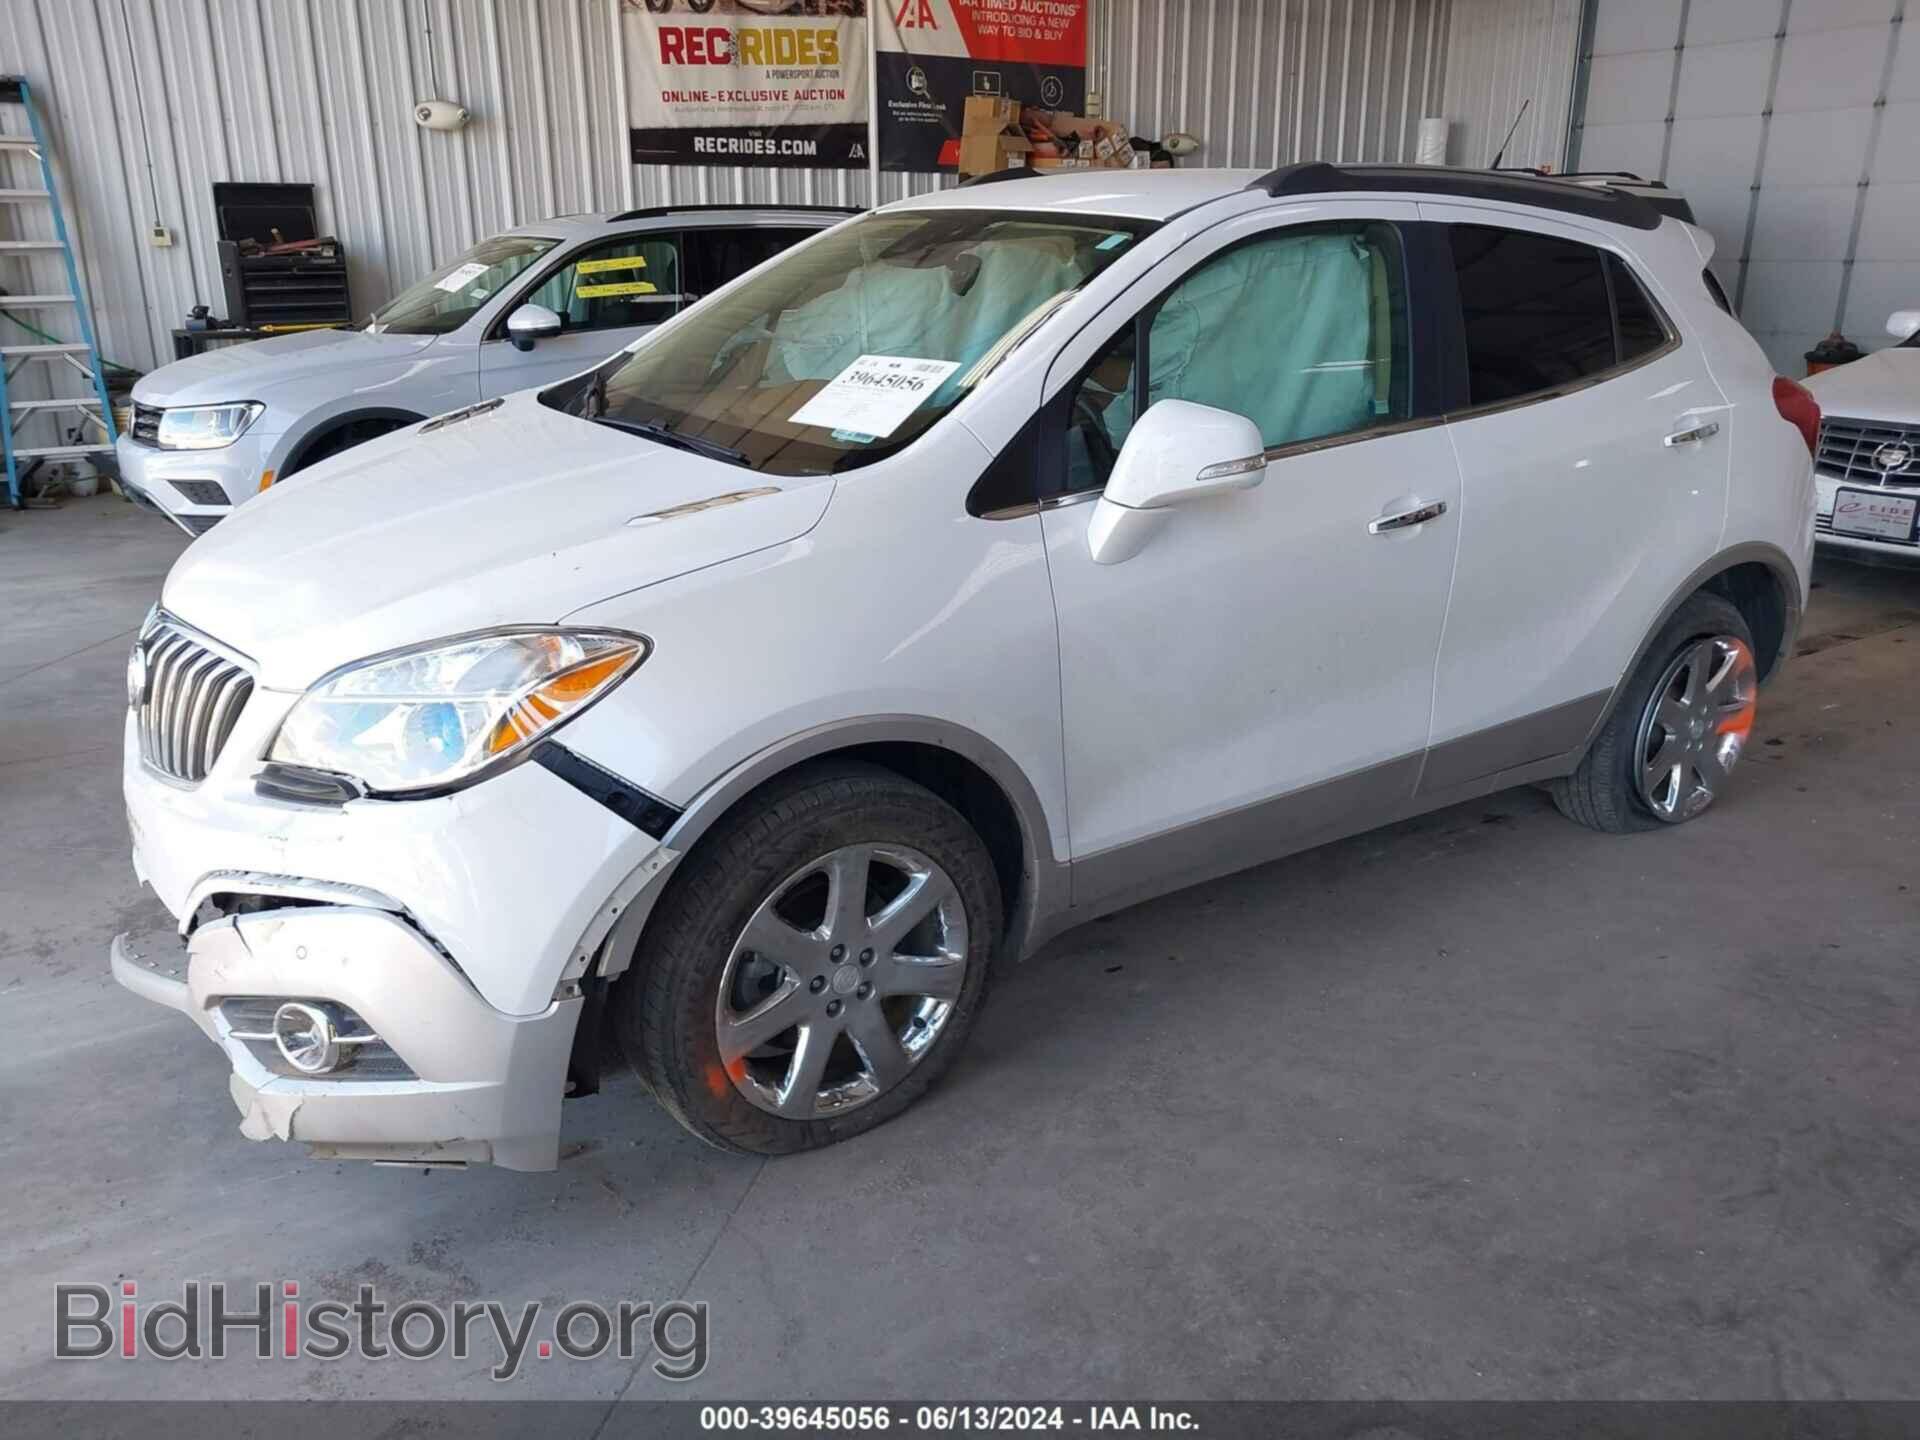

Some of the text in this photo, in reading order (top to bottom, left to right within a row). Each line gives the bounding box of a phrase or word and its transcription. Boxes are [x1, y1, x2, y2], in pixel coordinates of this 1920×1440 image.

[972, 10, 1071, 29] INTRODUCING A NEW
[977, 24, 1063, 40] WAY TO BID & BUY
[658, 27, 838, 66] REC RIDES
[765, 69, 840, 79] A POWERSPORT AUCTION
[662, 89, 845, 102] ONLINE-EXCLUSIVE AUCTION
[694, 136, 816, 155] RECRIDES.COM
[849, 371, 926, 391] 39645056
